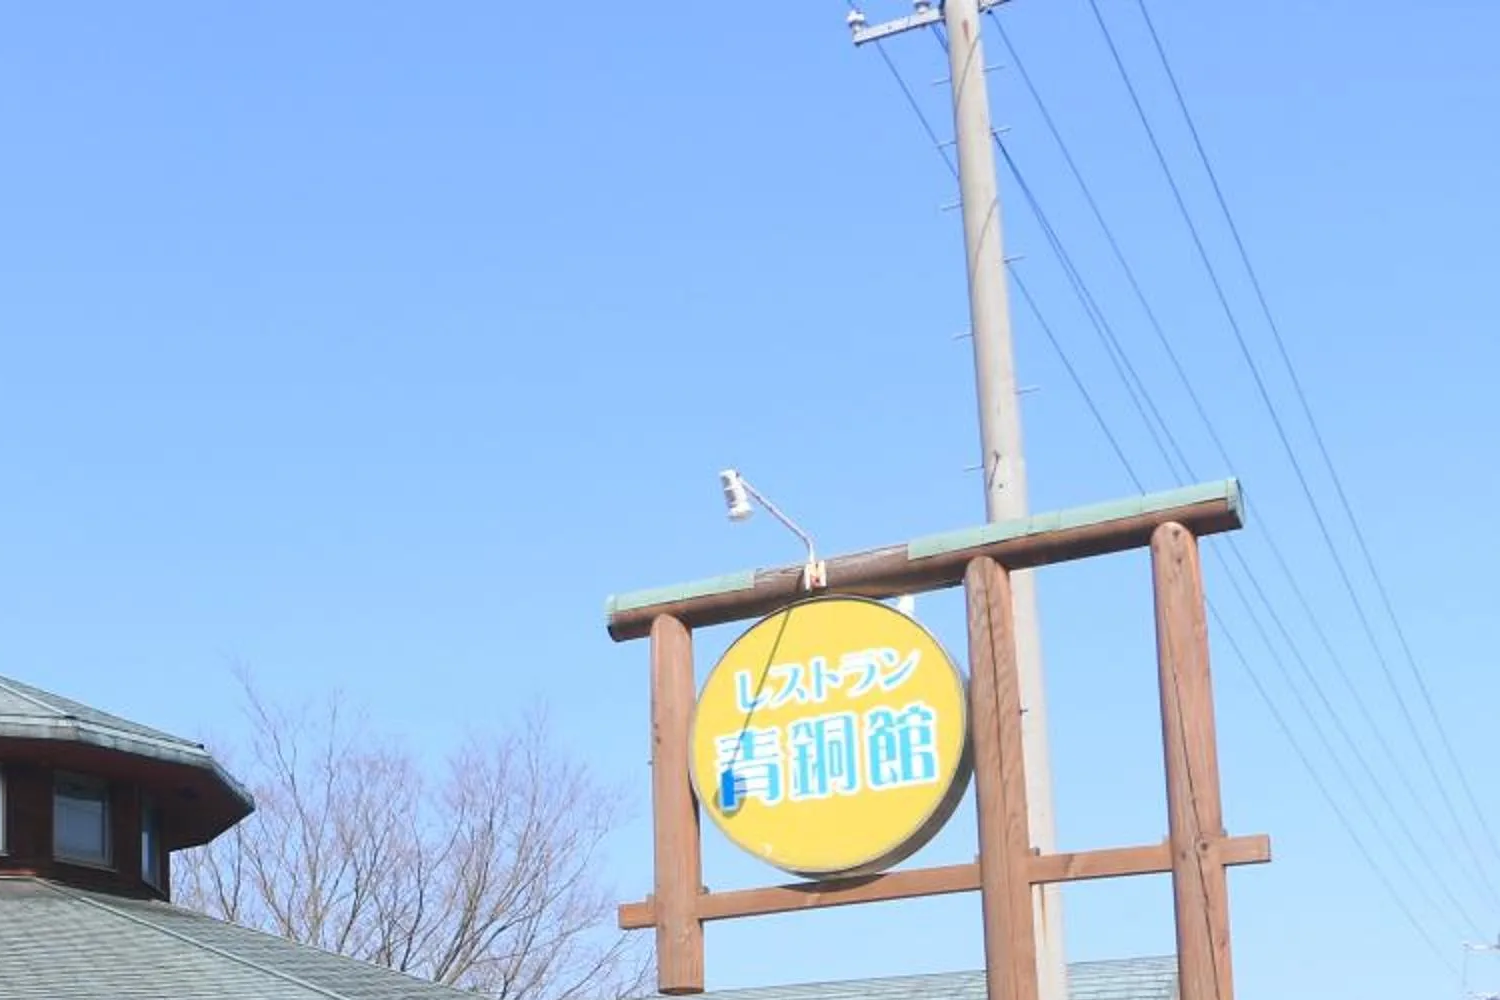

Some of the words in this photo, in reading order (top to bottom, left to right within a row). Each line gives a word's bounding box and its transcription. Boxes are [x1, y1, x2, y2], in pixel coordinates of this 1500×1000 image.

[737, 649, 920, 711] レストラン
[717, 702, 938, 809] 青銅館
